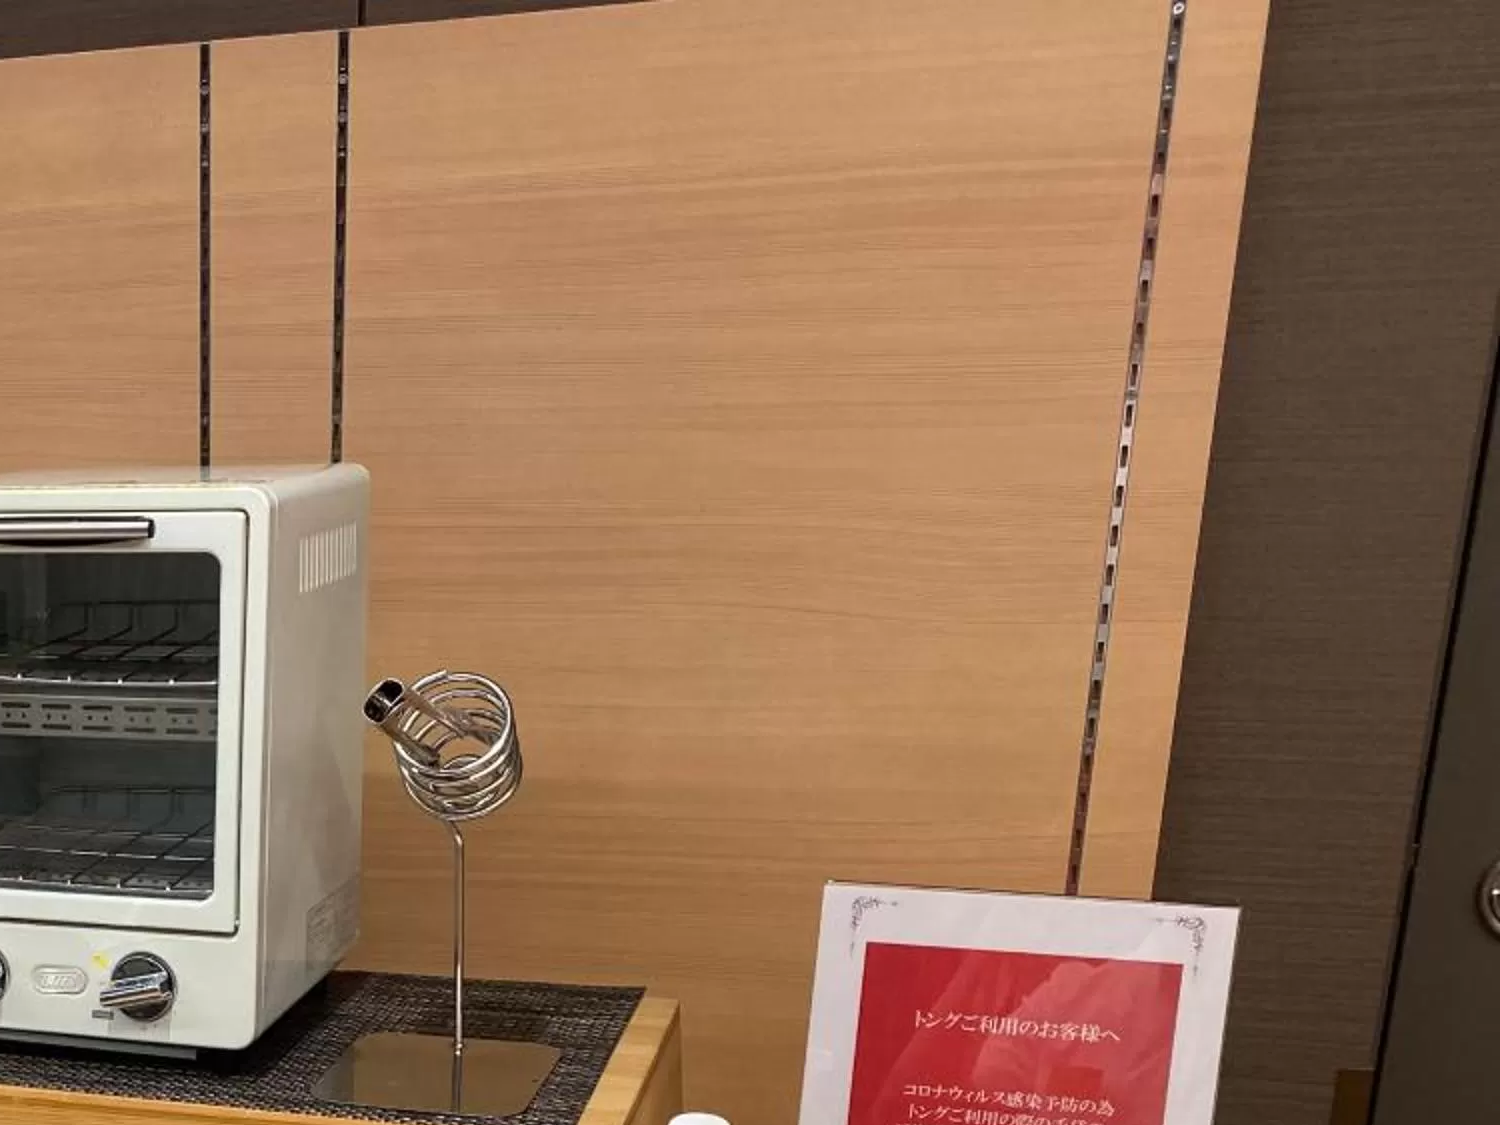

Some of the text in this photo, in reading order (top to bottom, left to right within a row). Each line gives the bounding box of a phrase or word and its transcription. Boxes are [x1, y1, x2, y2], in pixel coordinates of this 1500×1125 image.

[914, 1009, 1121, 1043] トングご利用のお客様へ
